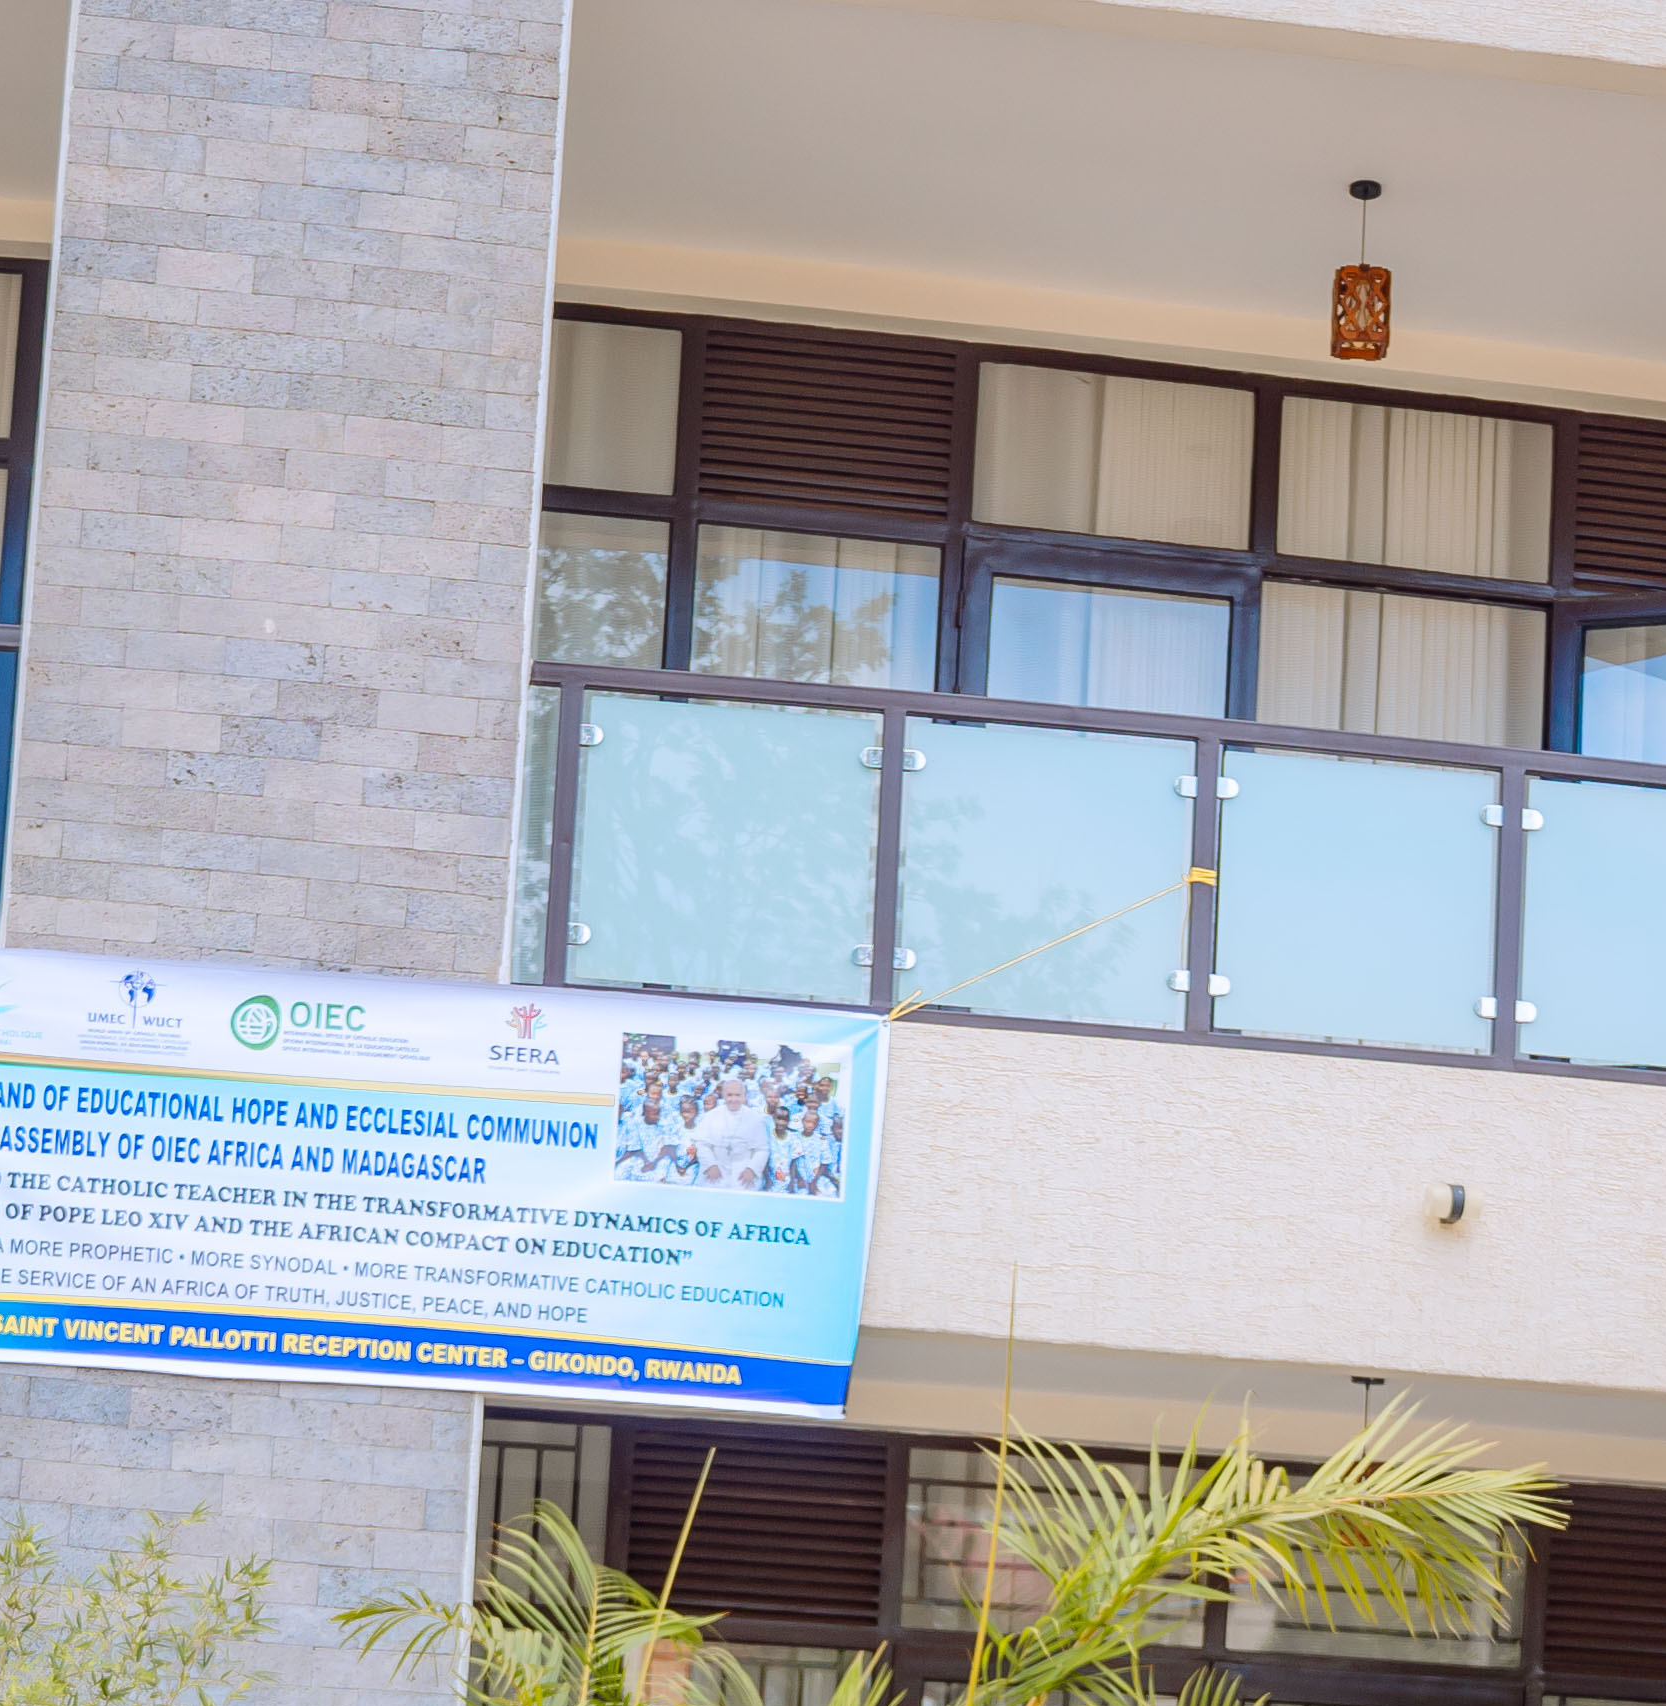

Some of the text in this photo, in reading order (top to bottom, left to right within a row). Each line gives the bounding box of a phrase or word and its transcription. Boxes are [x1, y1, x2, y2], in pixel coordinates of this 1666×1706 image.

[87, 1012, 126, 1025] UMEC
[143, 1016, 183, 1028] WUCT
[290, 1001, 366, 1032] OIEC
[488, 1045, 560, 1065] SFERA
[43, 1083, 71, 1113] OF
[76, 1086, 225, 1124] EDUCATIONAL
[231, 1097, 290, 1128] HOPE
[294, 1101, 339, 1131] AND
[345, 1105, 460, 1140] ECCLESIAL
[467, 1113, 599, 1150] COMMUNION
[117, 1132, 146, 1161] OF
[151, 1135, 202, 1165] OIEC
[207, 1138, 285, 1171] AFRICA
[290, 1144, 335, 1174] AND
[342, 1148, 487, 1185] MADAGASCAR
[5, 1202, 35, 1222] OF
[39, 1204, 96, 1225] POPE
[101, 1208, 143, 1228] LEO
[148, 1212, 190, 1231] XIV
[194, 1215, 244, 1235] AND
[249, 1219, 294, 1239] THE
[298, 1222, 400, 1246] AFRICAN
[405, 1230, 511, 1254] COMPACT
[515, 1237, 548, 1256] ON
[7, 1171, 52, 1191] THE
[57, 1175, 169, 1199] CATHOLIC
[174, 1183, 278, 1207] TEACHER
[283, 1190, 309, 1209] IN
[313, 1192, 358, 1213] THE
[362, 1196, 569, 1227] TRANSFORMATIVE
[573, 1210, 690, 1237] DYNAMICS
[694, 1220, 725, 1240] OF
[726, 1222, 812, 1247] AFRICA
[10, 1238, 64, 1258] MORE
[69, 1242, 174, 1265] PROPHETIC
[191, 1250, 245, 1270] MORE
[250, 1254, 338, 1276] SYNODAL
[355, 1261, 409, 1281] MORE
[414, 1265, 580, 1294] TRANSFORMATIVE
[585, 1277, 676, 1301] CATHOLIC
[680, 1285, 786, 1310] EDUCATION
[17, 1269, 97, 1291] SERVICE
[102, 1274, 127, 1292] OF
[130, 1277, 157, 1294] AN
[161, 1279, 230, 1299] AFRICA
[235, 1283, 260, 1301] OF
[265, 1285, 330, 1308] TRUTH,
[335, 1290, 417, 1314] JUSTICE,
[422, 1296, 489, 1319] PEACE,
[493, 1301, 533, 1320] AND
[537, 1304, 589, 1324] HOPE
[62, 1318, 166, 1346] VINCENT
[168, 1325, 278, 1353] PALLOTTI
[281, 1333, 412, 1362] RECEPTION
[416, 1341, 509, 1369] CENTER
[528, 1350, 641, 1383] GIKONDO,
[644, 1358, 743, 1386] RWANDA
